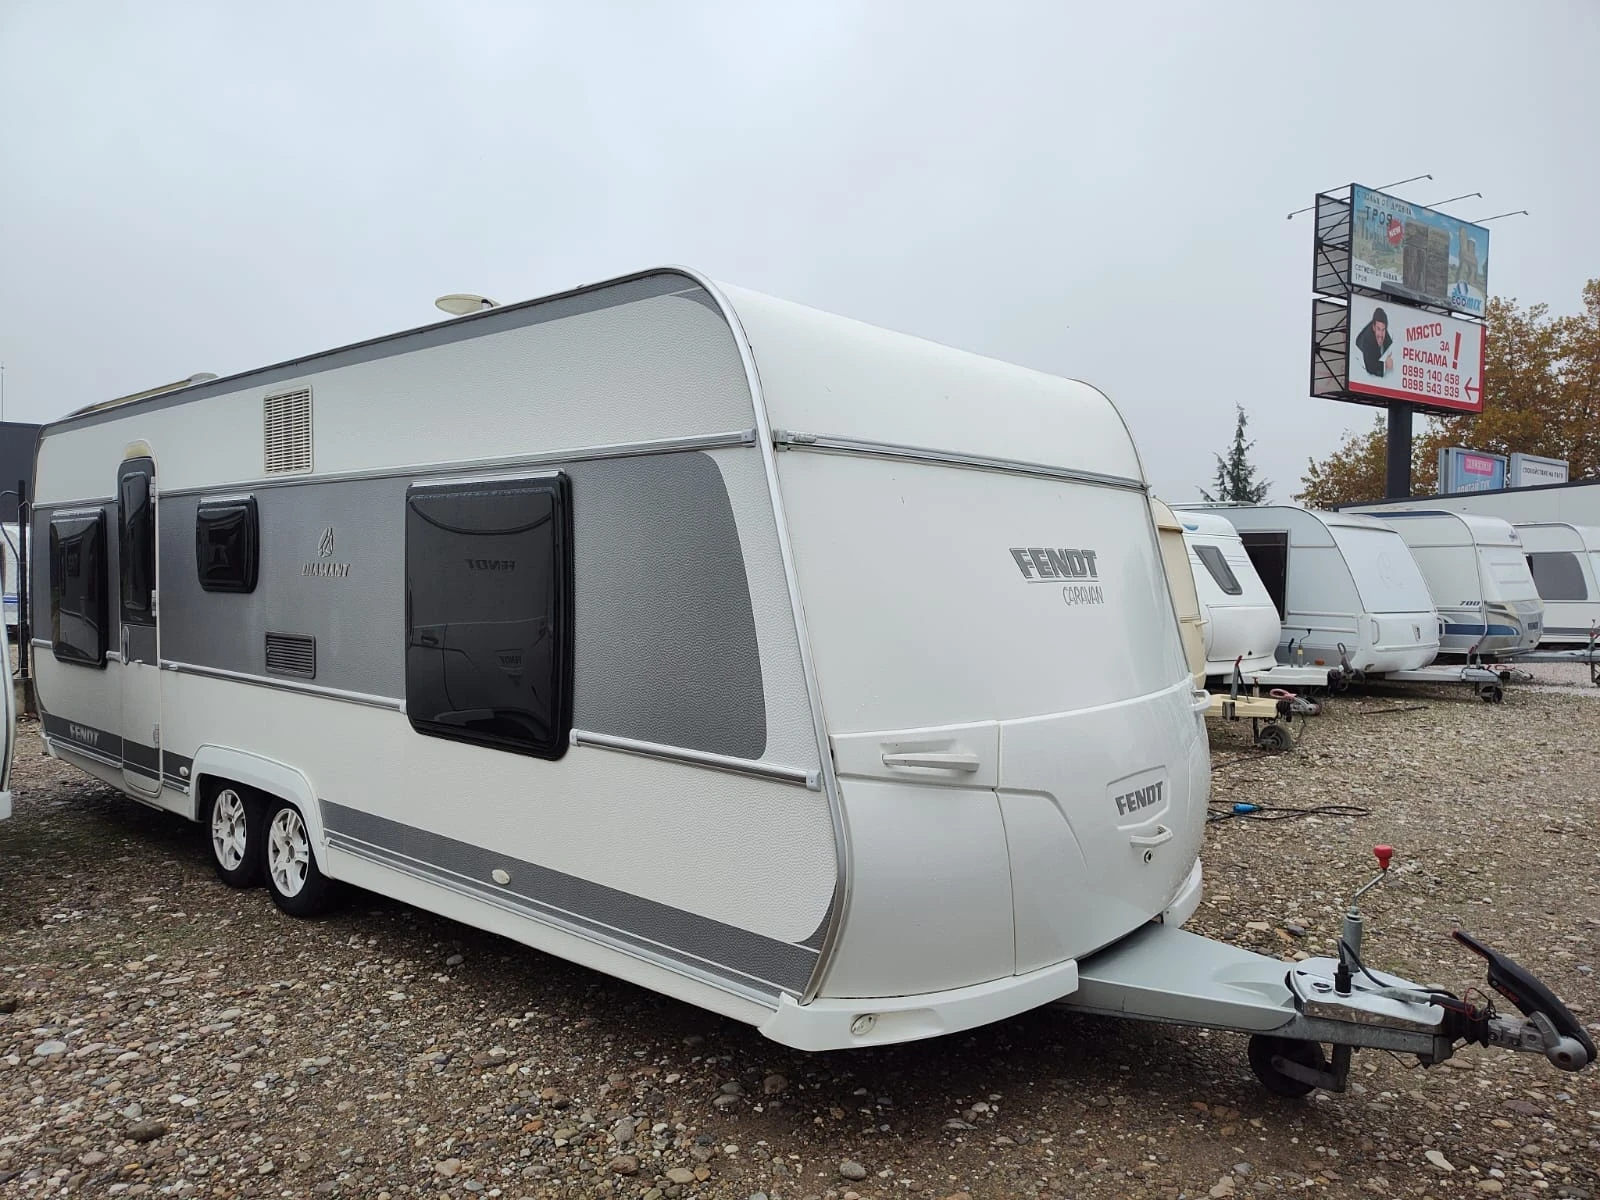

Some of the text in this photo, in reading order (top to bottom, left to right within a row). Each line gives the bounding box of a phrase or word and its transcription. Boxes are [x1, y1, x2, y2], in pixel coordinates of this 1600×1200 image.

[1406, 322, 1442, 342] МЯСТО
[1440, 340, 1450, 352] ЗА
[1402, 347, 1448, 368] РЕКЛАМА
[1402, 364, 1460, 385] 0899 140 458
[1426, 382, 1442, 395] 543
[1444, 386, 1460, 398] 939
[1009, 547, 1098, 579] FENDT
[1062, 585, 1105, 606] CARAVAN
[70, 722, 99, 746] FENDT
[1115, 780, 1164, 816] FENDT
